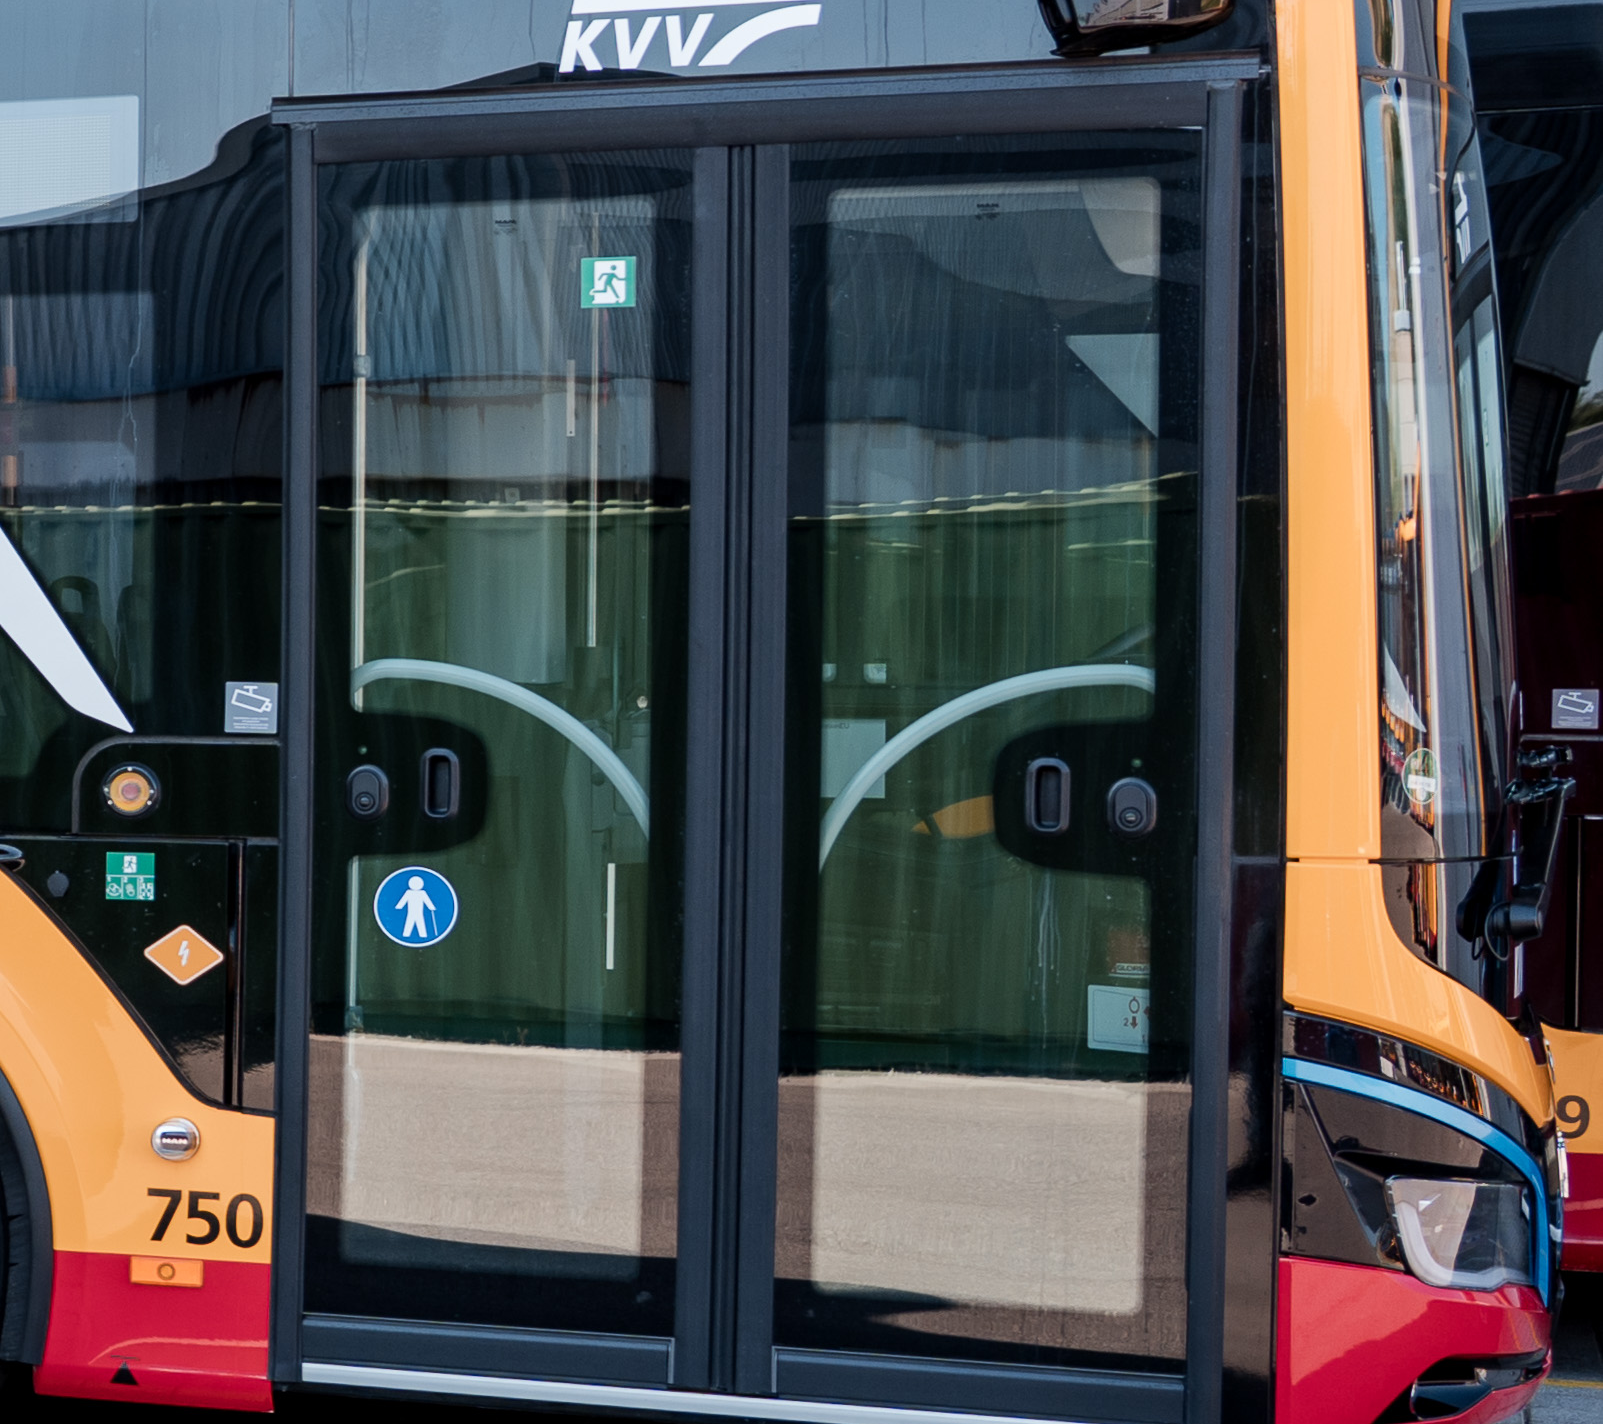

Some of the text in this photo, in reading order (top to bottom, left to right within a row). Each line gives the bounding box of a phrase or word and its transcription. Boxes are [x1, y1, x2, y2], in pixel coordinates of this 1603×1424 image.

[557, 12, 715, 73] KVV
[1556, 1095, 1590, 1140] 9
[147, 1187, 264, 1248] 750
